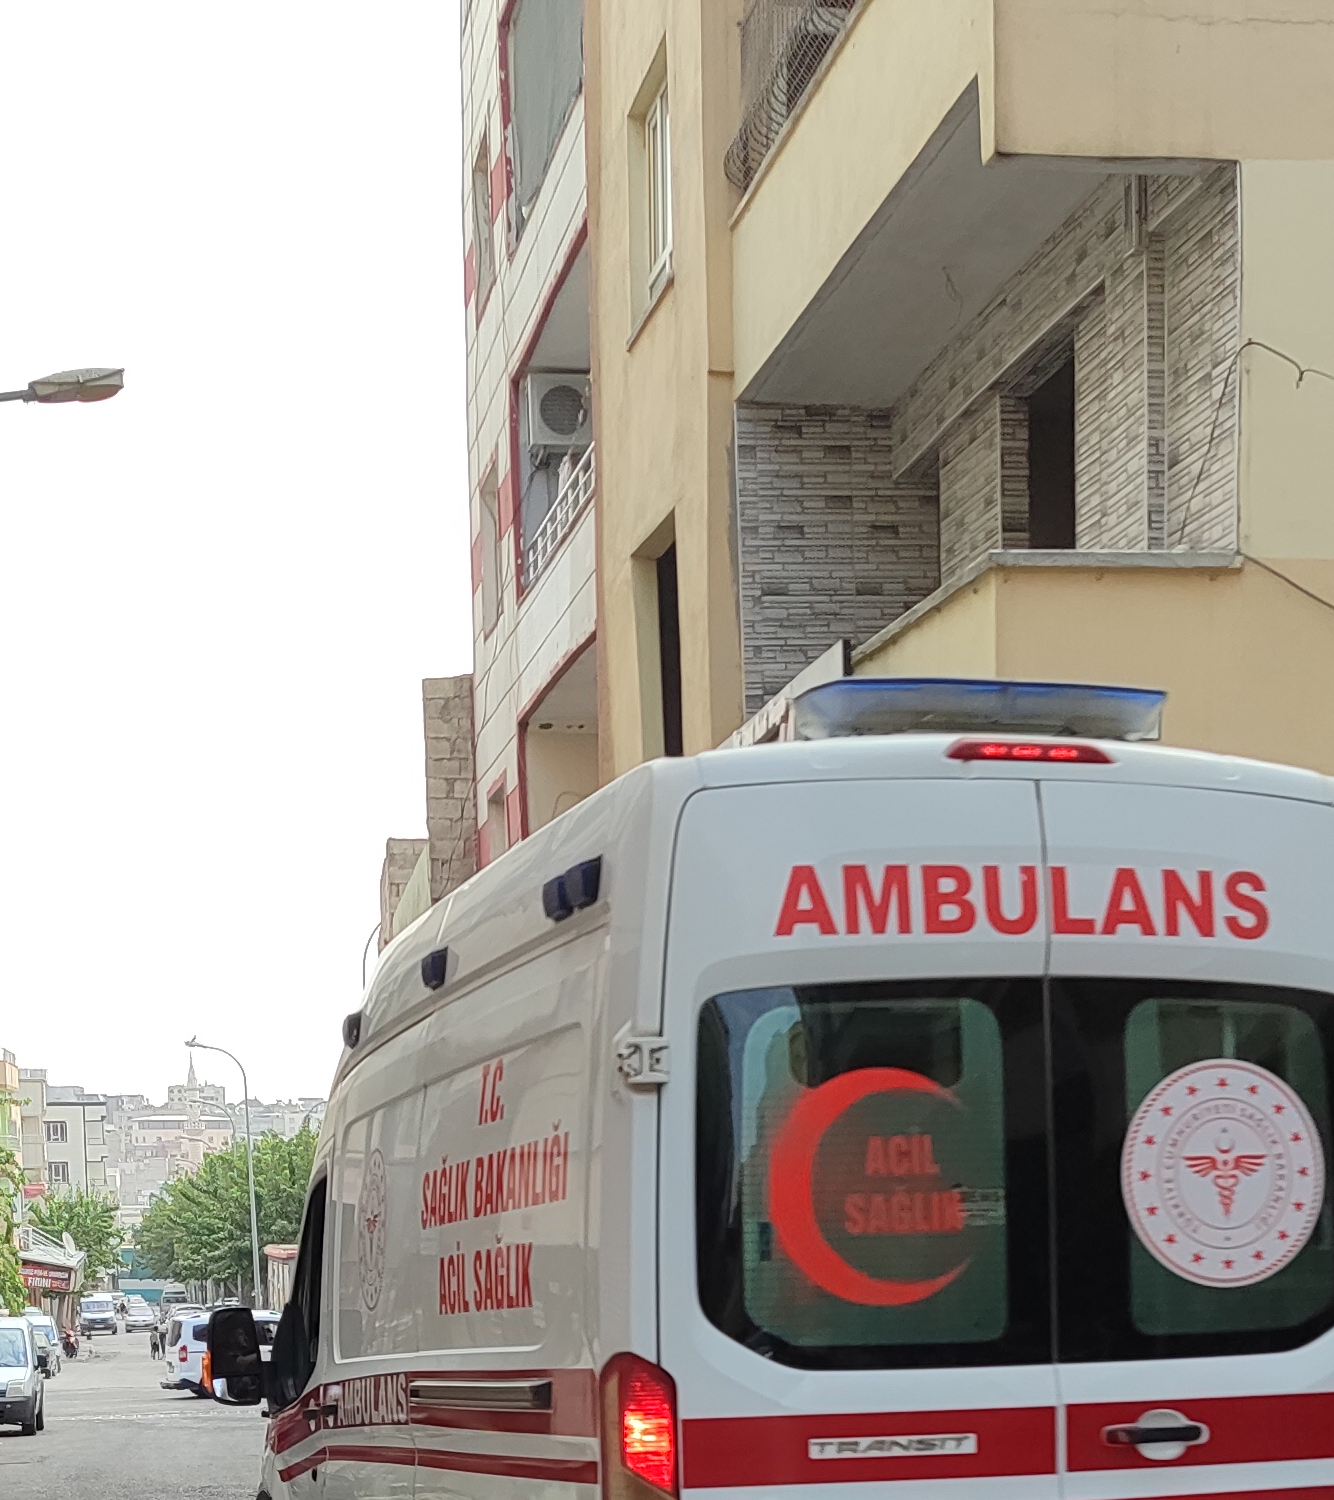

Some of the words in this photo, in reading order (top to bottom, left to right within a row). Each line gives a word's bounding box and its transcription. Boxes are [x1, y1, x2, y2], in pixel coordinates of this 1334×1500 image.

[773, 863, 1269, 940] AMBULANS
[421, 1154, 471, 1231] SAĞLIK
[472, 1118, 570, 1218] BAKANLIĞI
[438, 1240, 471, 1316] ACİL
[472, 1233, 534, 1312] SAĞLIK
[337, 1373, 408, 1427] AMBULANS
[811, 1435, 971, 1455] TRANSIT
